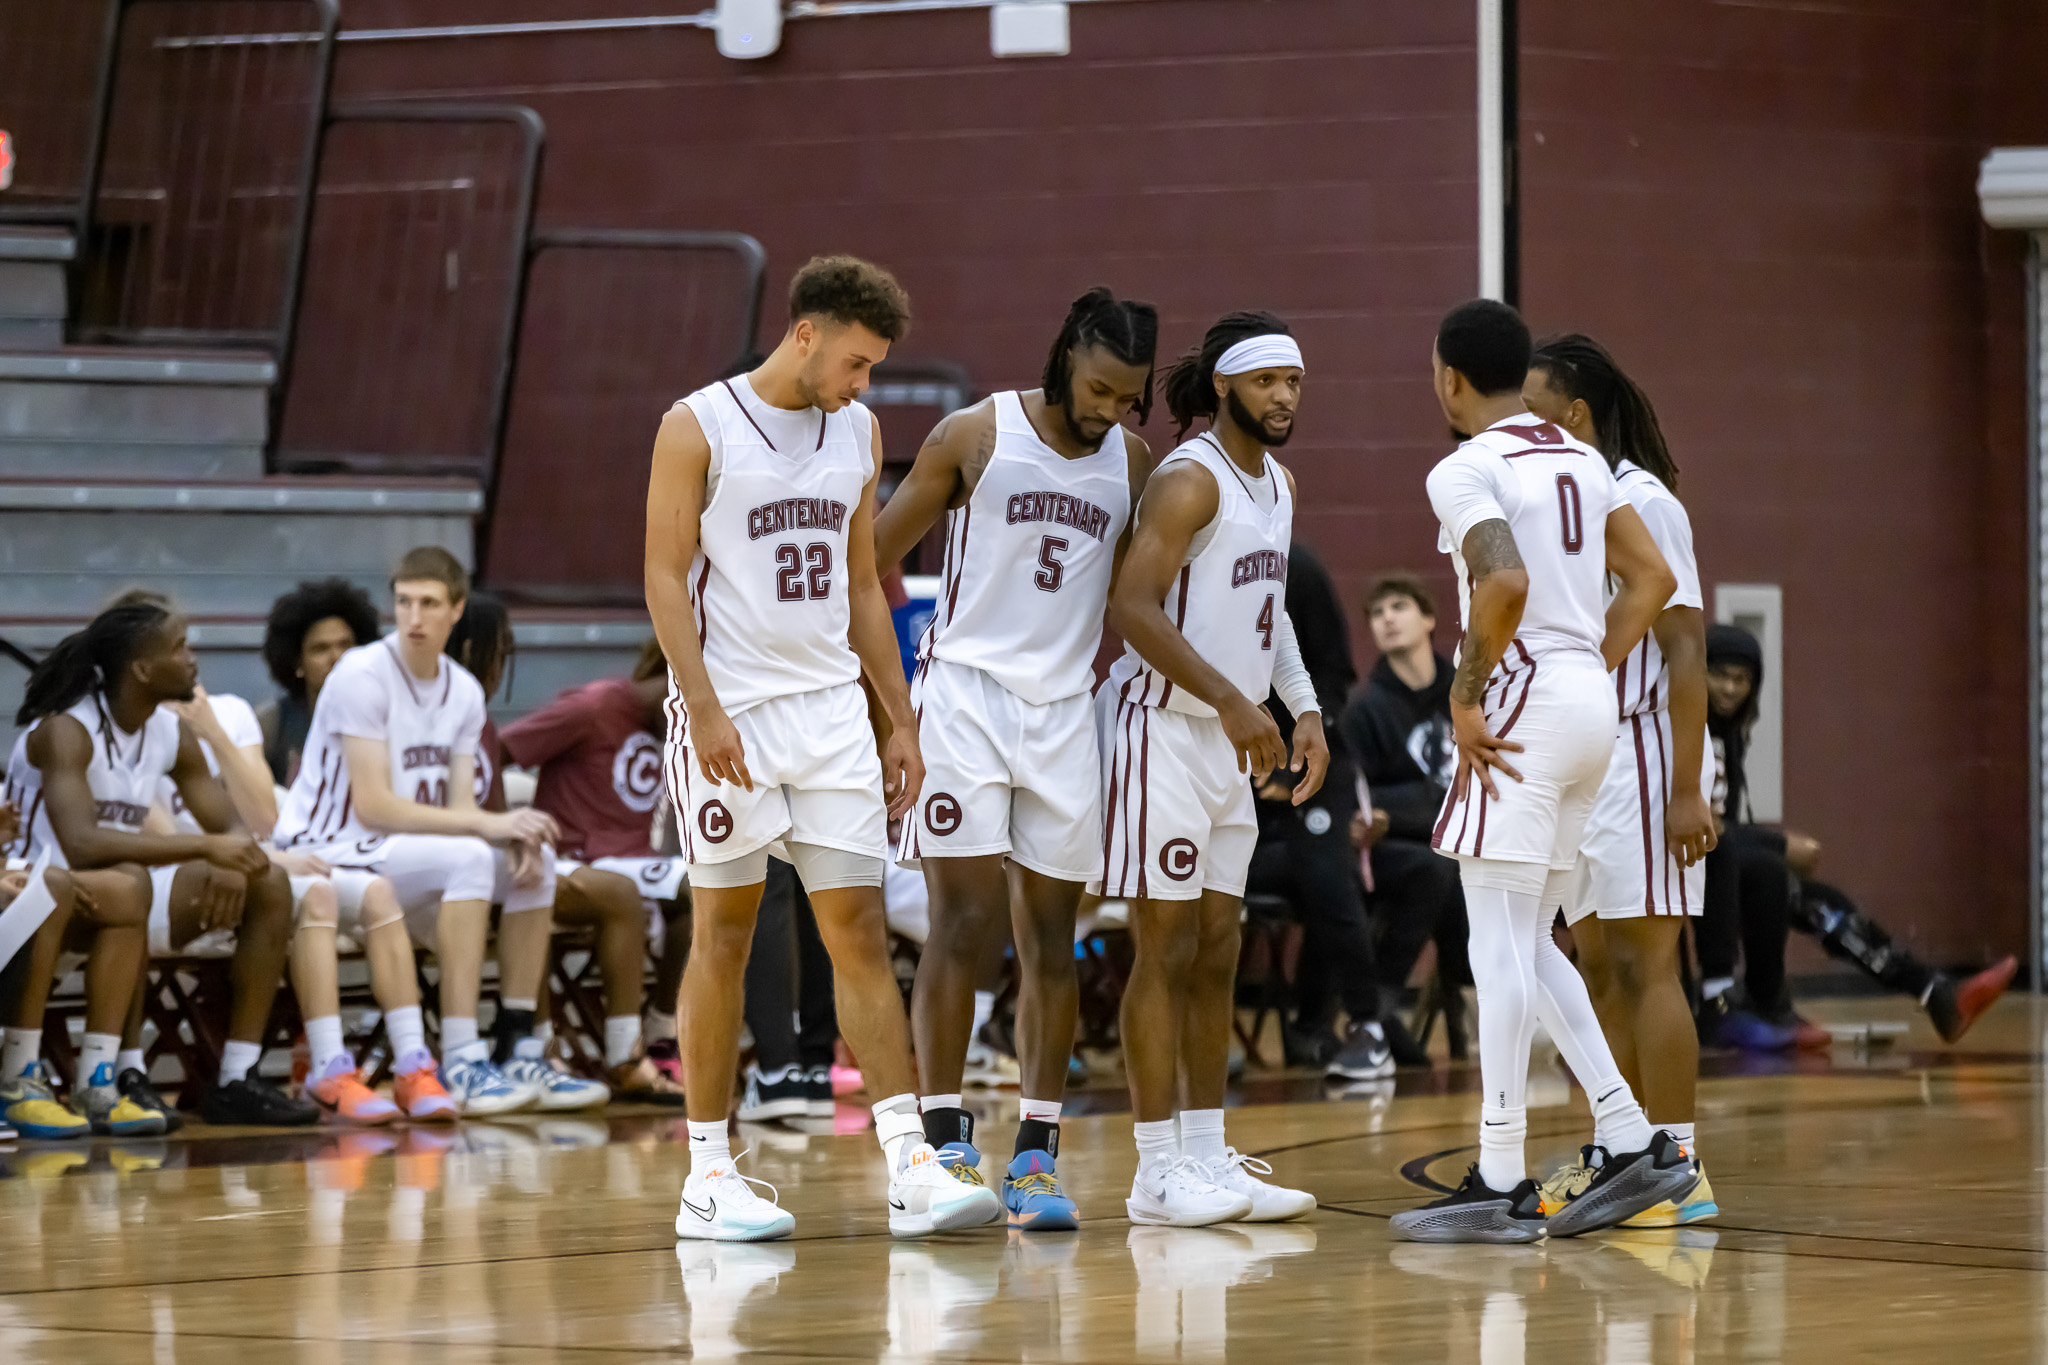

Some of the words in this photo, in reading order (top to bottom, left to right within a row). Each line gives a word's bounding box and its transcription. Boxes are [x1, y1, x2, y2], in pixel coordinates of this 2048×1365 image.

[747, 498, 848, 541] CENTENARY
[1006, 491, 1112, 542] CENTENARY
[1555, 473, 1584, 555] 0
[775, 542, 833, 602] 22
[1034, 535, 1069, 593] 5
[1256, 593, 1275, 650] 4
[704, 805, 728, 840] C
[928, 797, 957, 832] C
[1166, 843, 1196, 877] C
